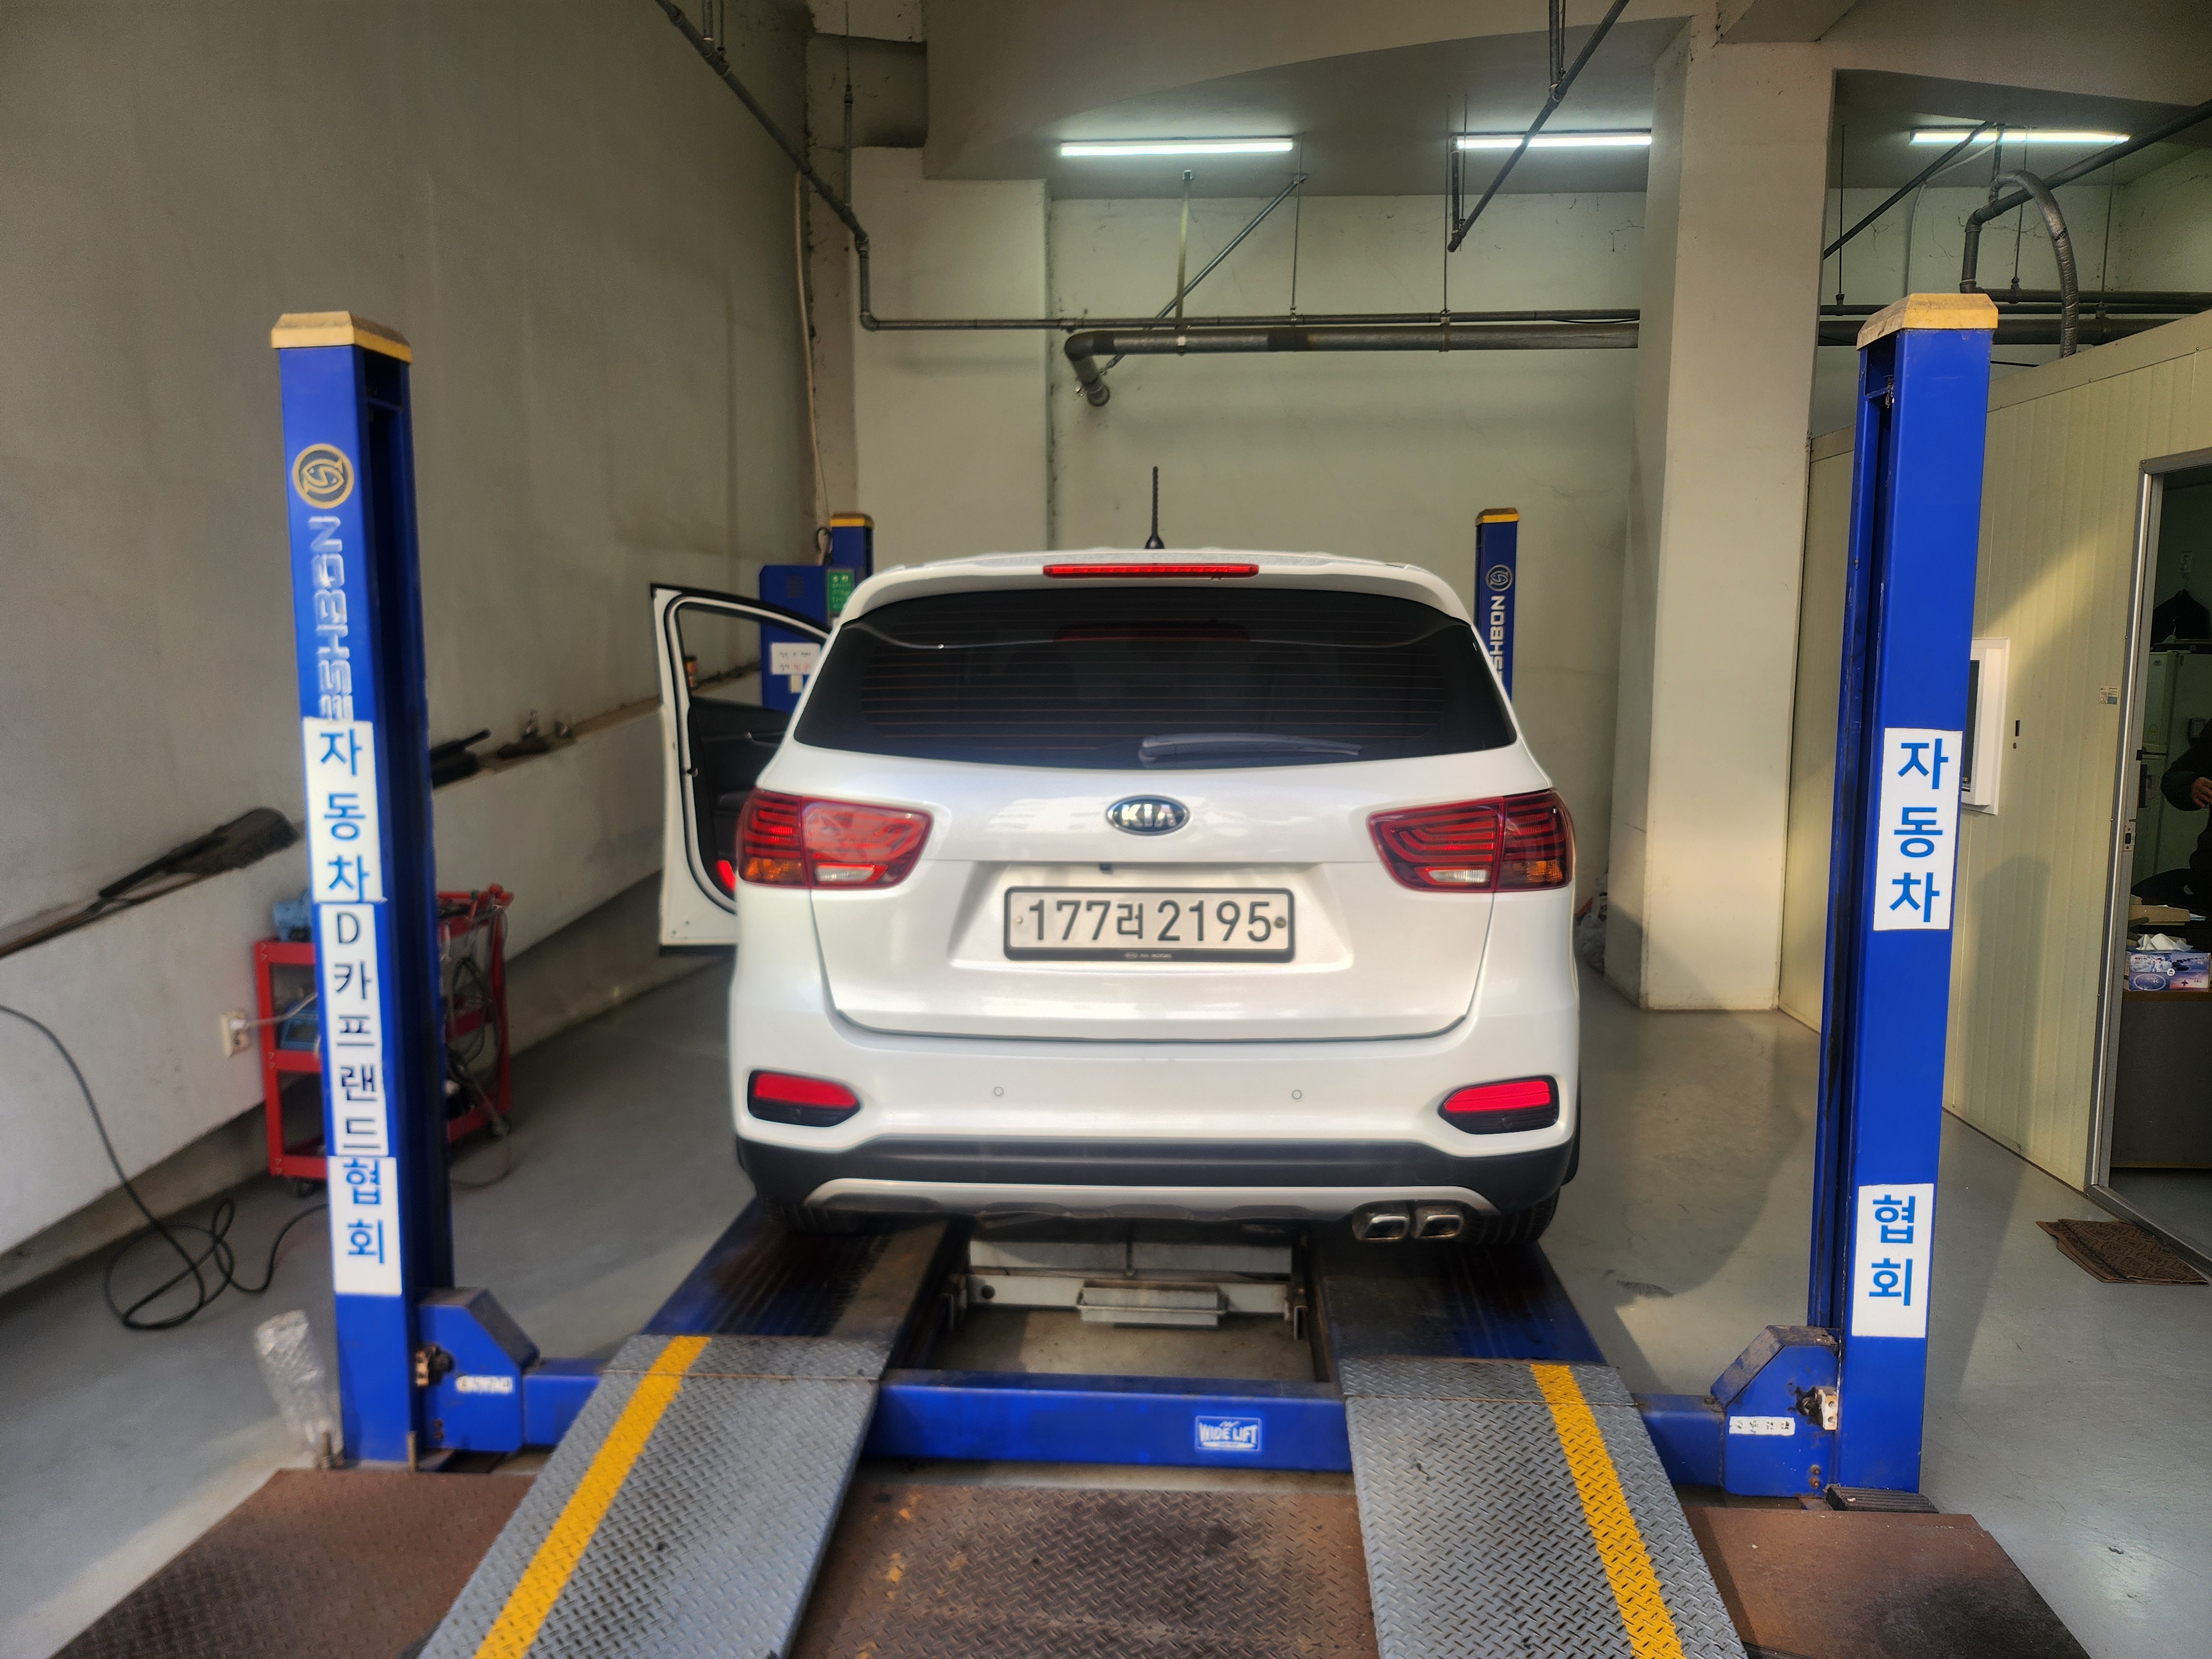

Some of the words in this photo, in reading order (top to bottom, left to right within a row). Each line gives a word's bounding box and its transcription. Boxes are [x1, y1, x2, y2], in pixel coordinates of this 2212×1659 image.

[320, 728, 369, 902] 자동차
[1121, 804, 1178, 827] KIA
[1889, 738, 1949, 922] 자동차
[343, 1159, 385, 1265] 협회
[1869, 1194, 1916, 1306] 협회
[1199, 1422, 1231, 1441] WIDE
[1233, 1425, 1258, 1444] LIFT
